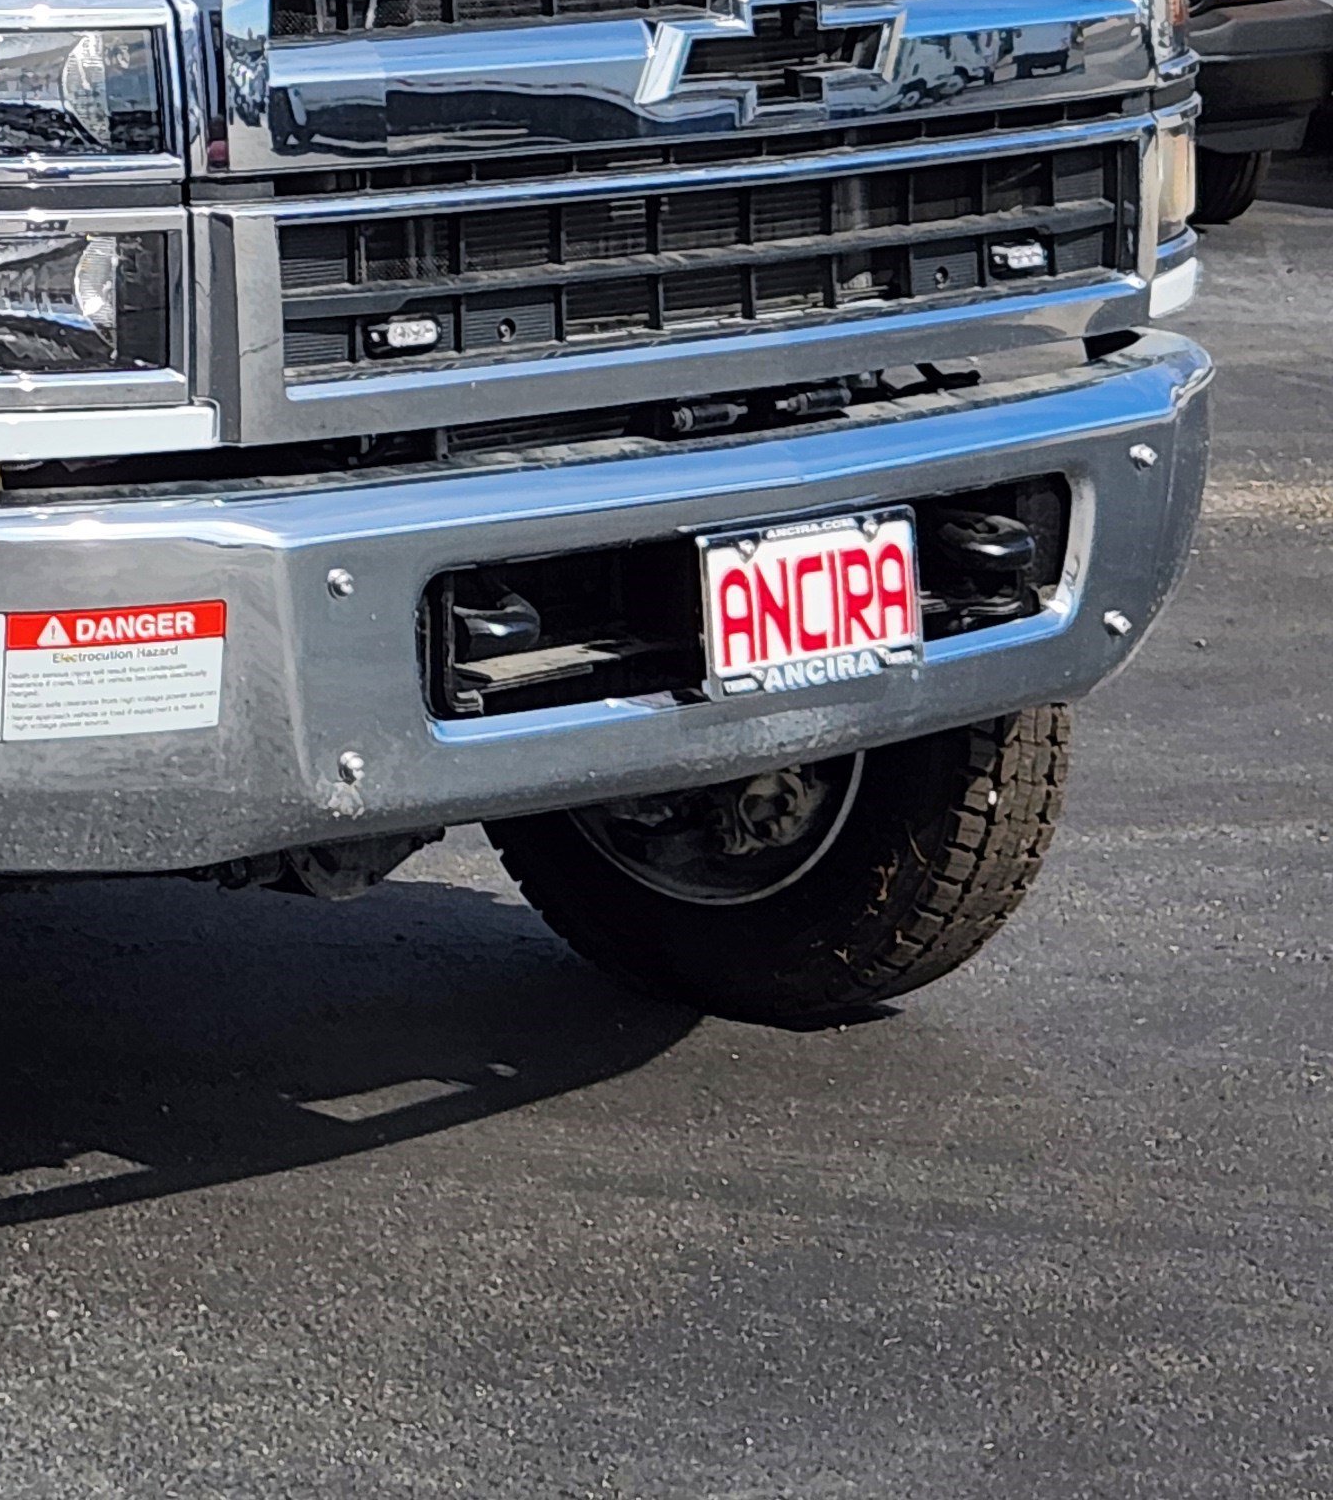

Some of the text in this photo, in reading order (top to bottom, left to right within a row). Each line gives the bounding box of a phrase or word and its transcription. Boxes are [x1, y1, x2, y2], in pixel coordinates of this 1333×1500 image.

[766, 518, 856, 539] ANCIRA.COM
[720, 543, 909, 667] ANCIRA
[75, 610, 196, 642] DANGER
[52, 645, 179, 664] Electrocution Hazard
[763, 651, 878, 693] ANCIRA
